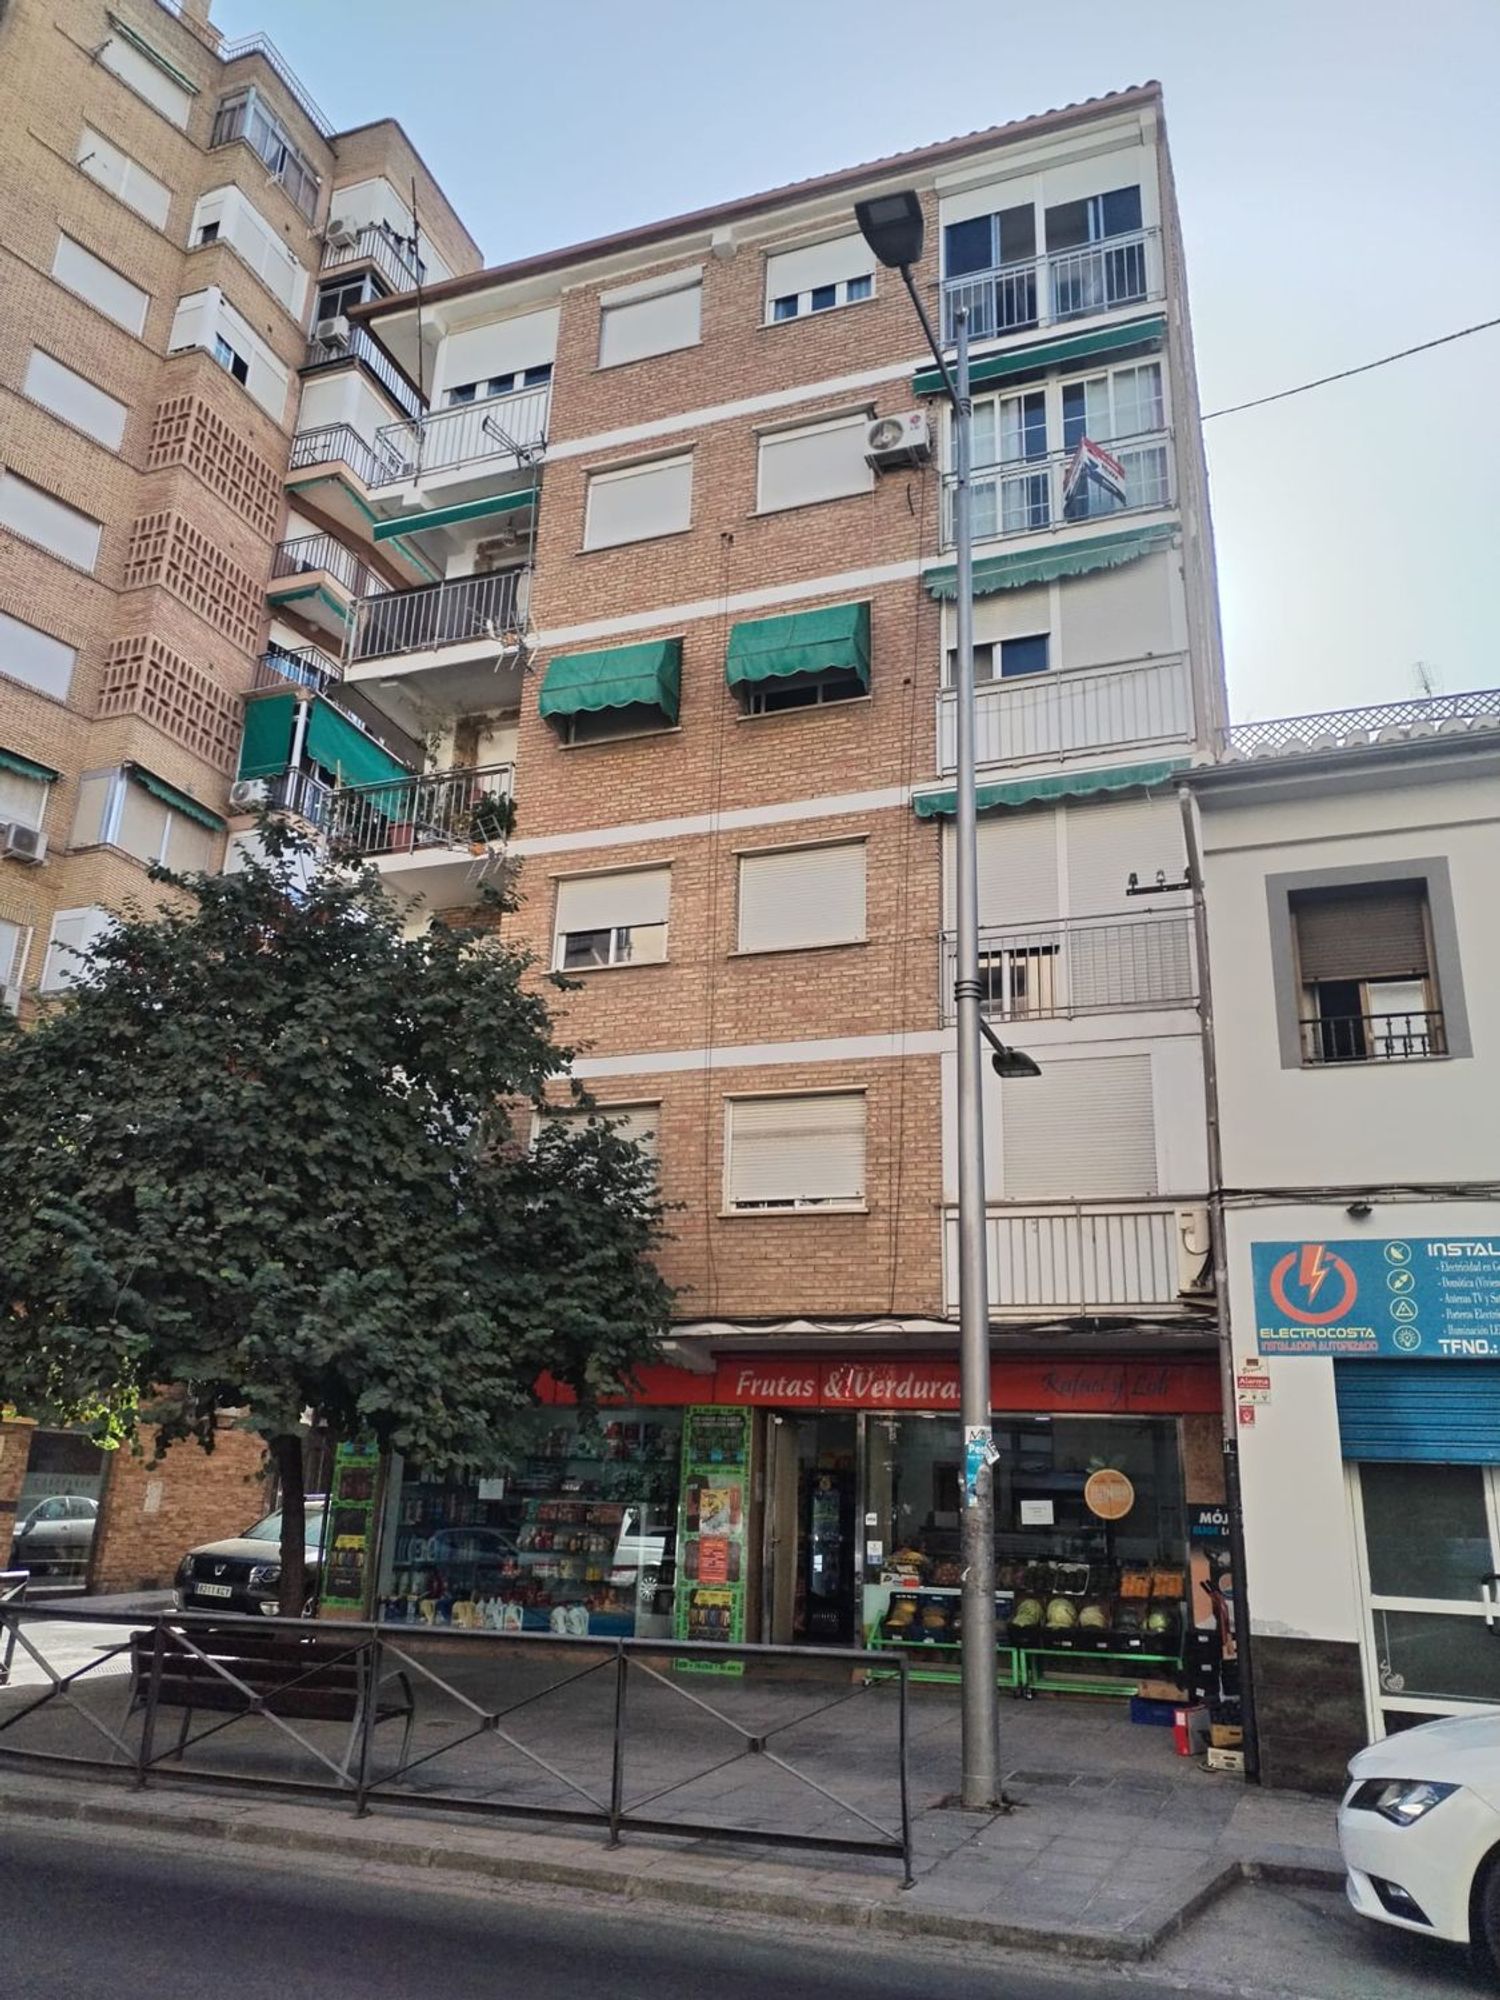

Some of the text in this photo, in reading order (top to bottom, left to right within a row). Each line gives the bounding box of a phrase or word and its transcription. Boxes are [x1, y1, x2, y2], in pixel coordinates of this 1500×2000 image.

[1259, 1327, 1376, 1339] ELECTROCOSTA
[736, 1370, 815, 1397] Frutas
[854, 1370, 961, 1399] Verdura
